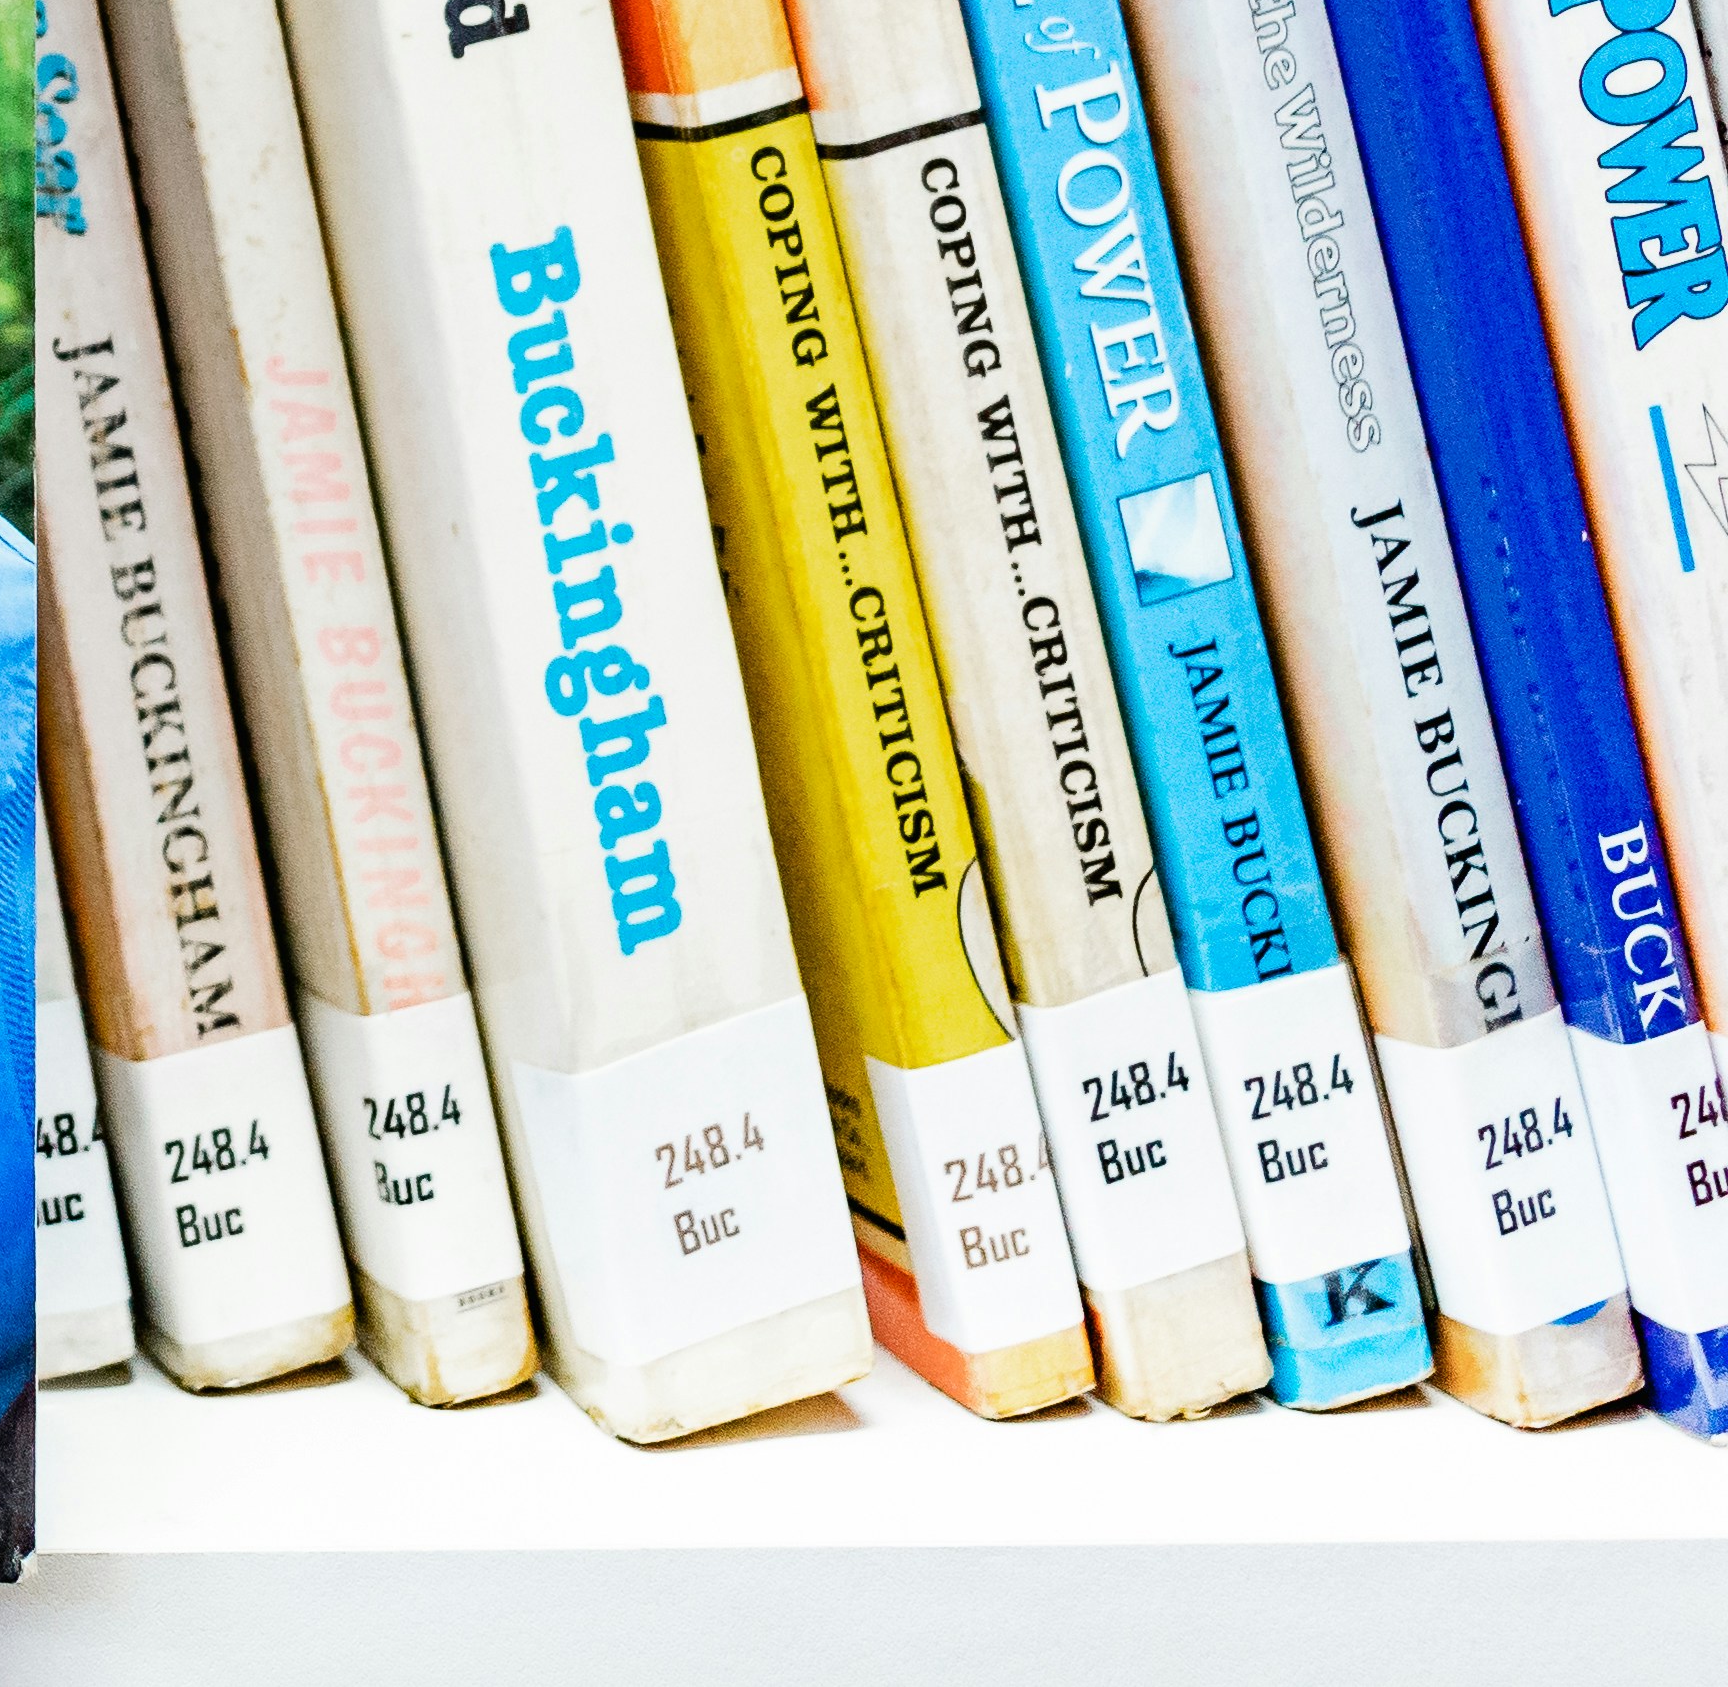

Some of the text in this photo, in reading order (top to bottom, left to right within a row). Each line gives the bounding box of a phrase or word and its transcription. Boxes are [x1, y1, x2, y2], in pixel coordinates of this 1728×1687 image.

[1026, 14, 1084, 64] of
[750, 144, 830, 368] COPING
[920, 157, 1002, 380] COPING
[1037, 60, 1180, 463] POWER
[1267, 83, 1381, 454] Wilderness
[1350, 498, 1445, 696] JAMIE
[264, 356, 366, 585] JAMIE
[489, 225, 683, 956] Buckingham
[53, 332, 146, 543] JAMIE
[110, 557, 240, 1041] BUCKINGHAM
[1167, 637, 1249, 799] JAMIE
[364, 1084, 463, 1140] 248.4
[1084, 1052, 1190, 1122] 248.4
[1244, 1054, 1355, 1121] 248.4
[164, 1119, 270, 1184] 248.4
[655, 1111, 766, 1191] 248.4
[1097, 1136, 1168, 1185] Buc
[1258, 1136, 1329, 1185] Buc
[1478, 1098, 1575, 1171] 248.4
[375, 1160, 435, 1205] Buc
[1493, 1187, 1557, 1236] Buc
[175, 1205, 245, 1248] Buc
[674, 1210, 740, 1256] Buc
[960, 1225, 1031, 1271] Buc
